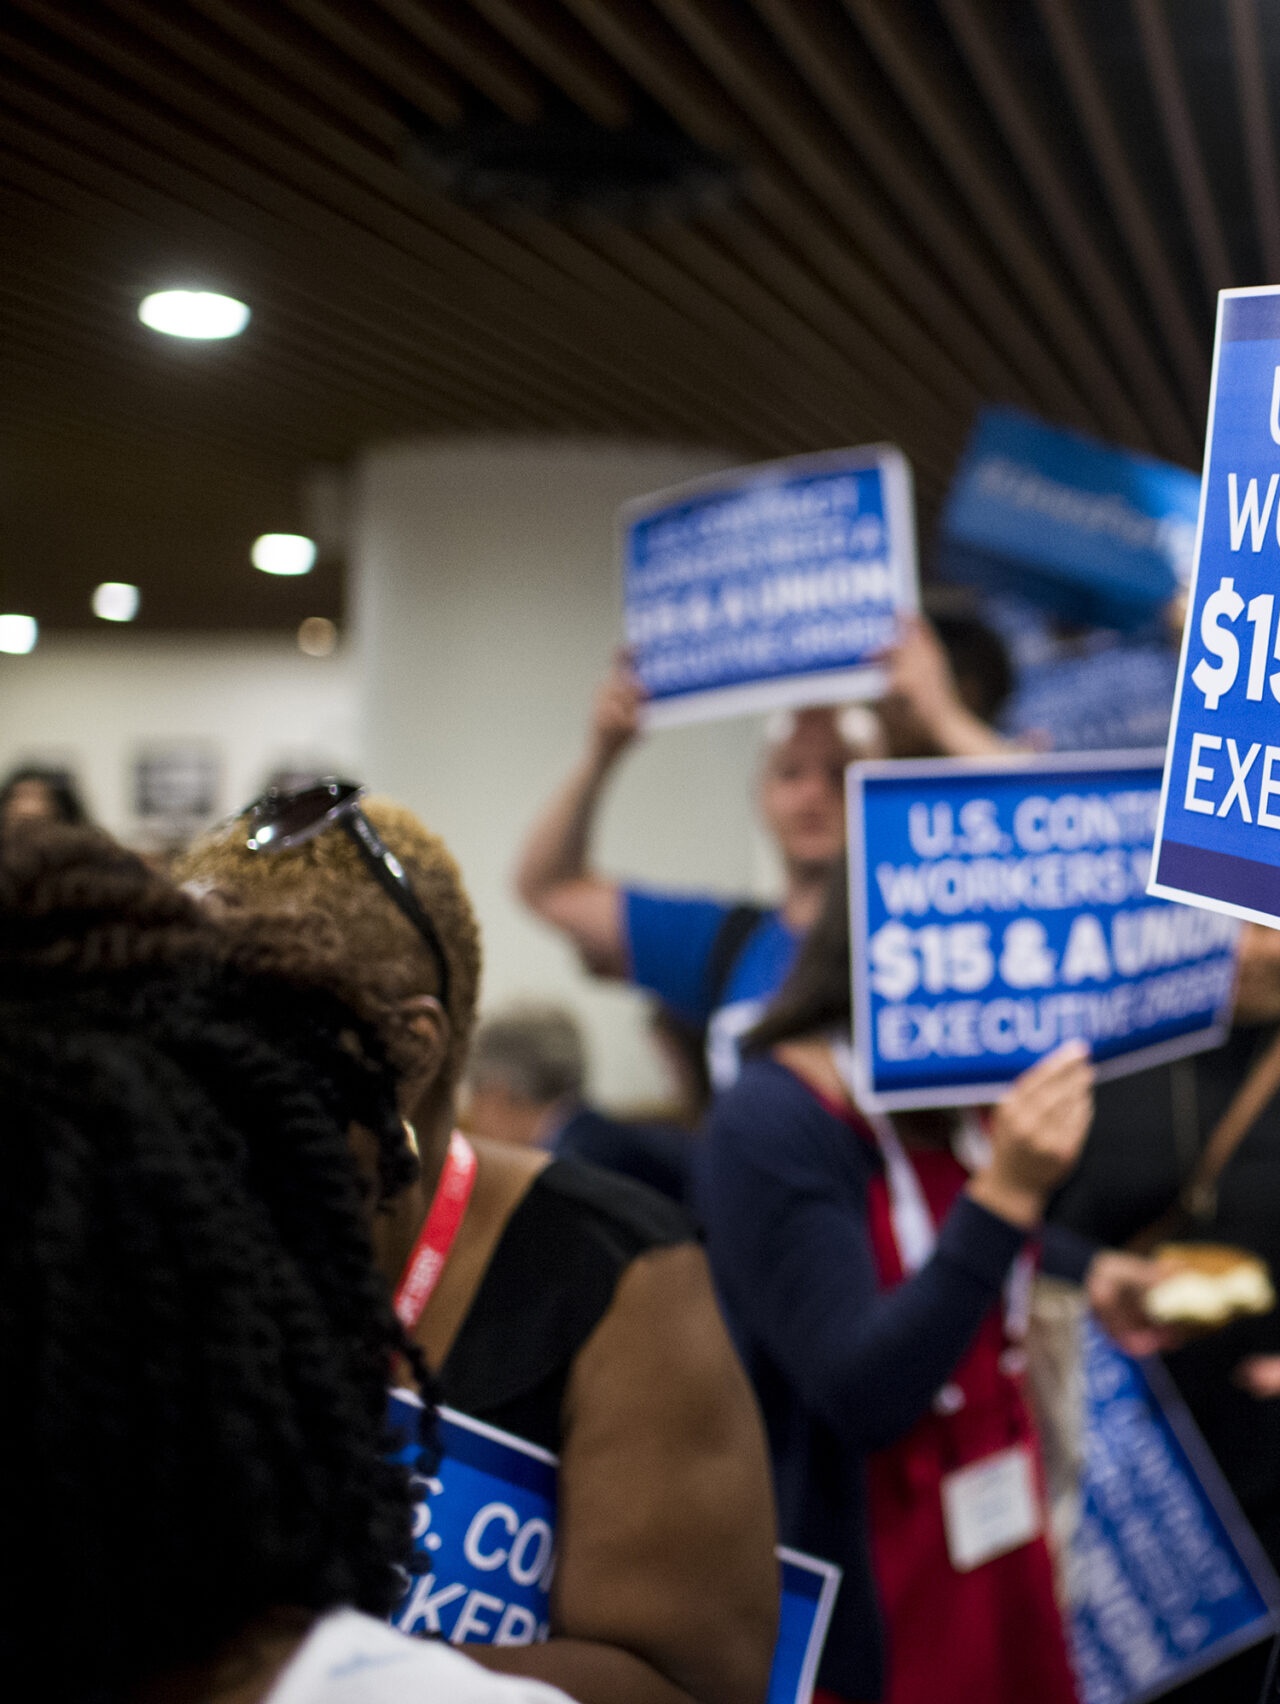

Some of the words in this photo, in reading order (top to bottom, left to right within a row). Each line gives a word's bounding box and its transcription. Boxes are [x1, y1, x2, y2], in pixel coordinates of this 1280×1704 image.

[909, 800, 1012, 858] U.S.
[877, 849, 1129, 915] WORKERS
[871, 920, 994, 1000] $15
[1001, 918, 1055, 989] &
[1063, 913, 1111, 985] A
[464, 1501, 556, 1593] CO
